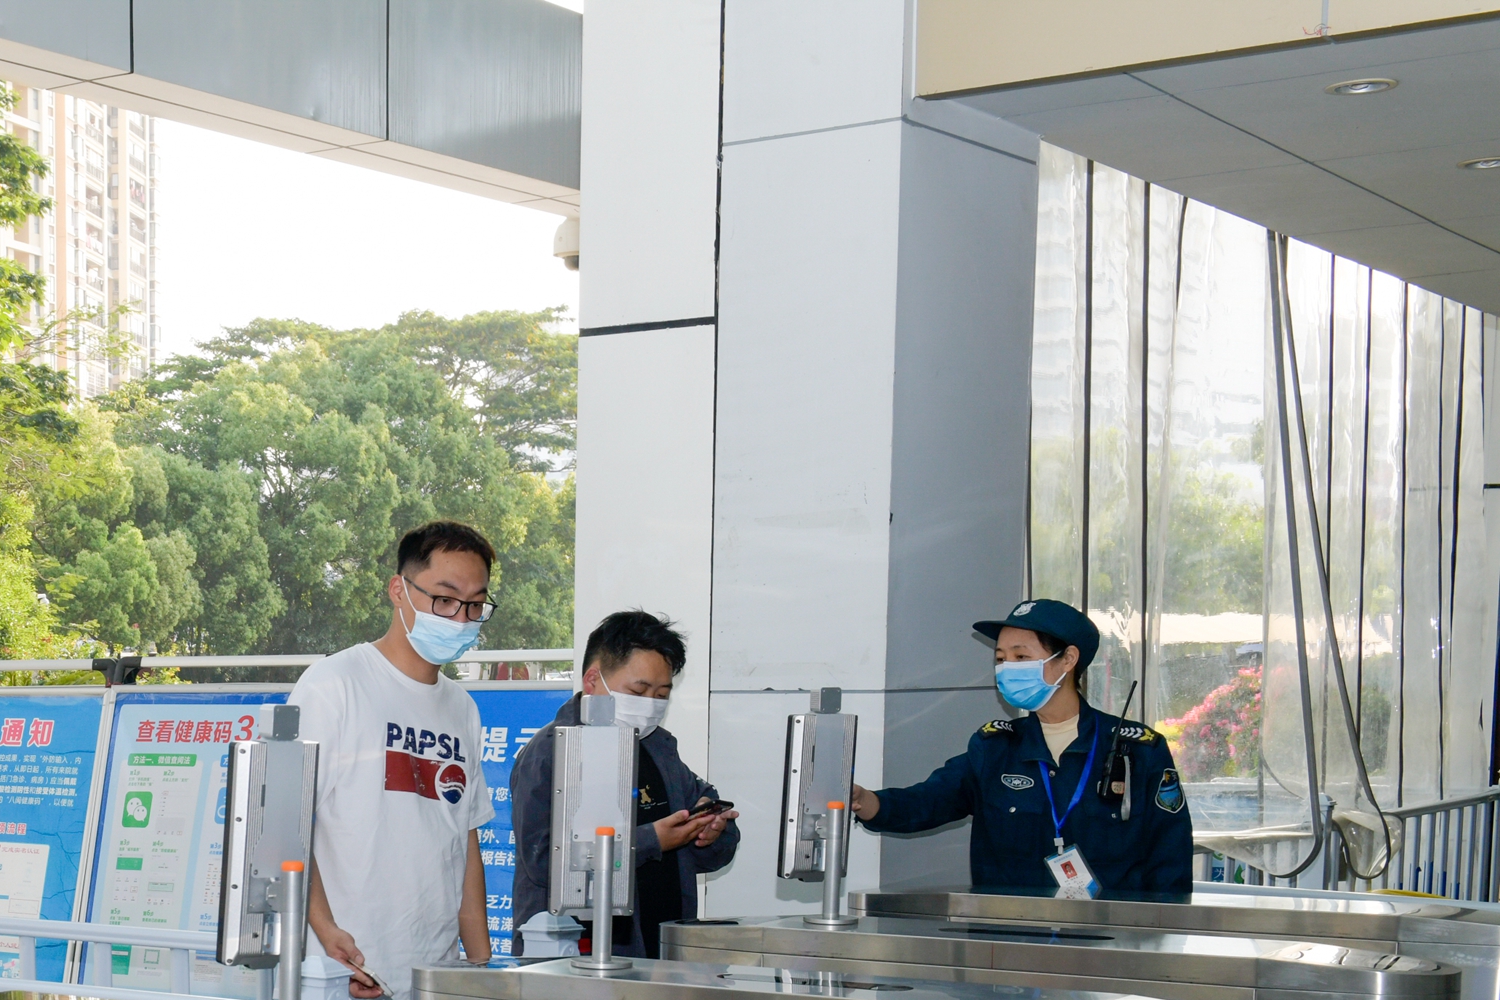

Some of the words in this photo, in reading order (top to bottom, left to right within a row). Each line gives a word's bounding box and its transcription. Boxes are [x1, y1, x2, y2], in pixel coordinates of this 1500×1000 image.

[135, 715, 262, 744] 查看健康码3
[386, 722, 466, 763] PAPSL
